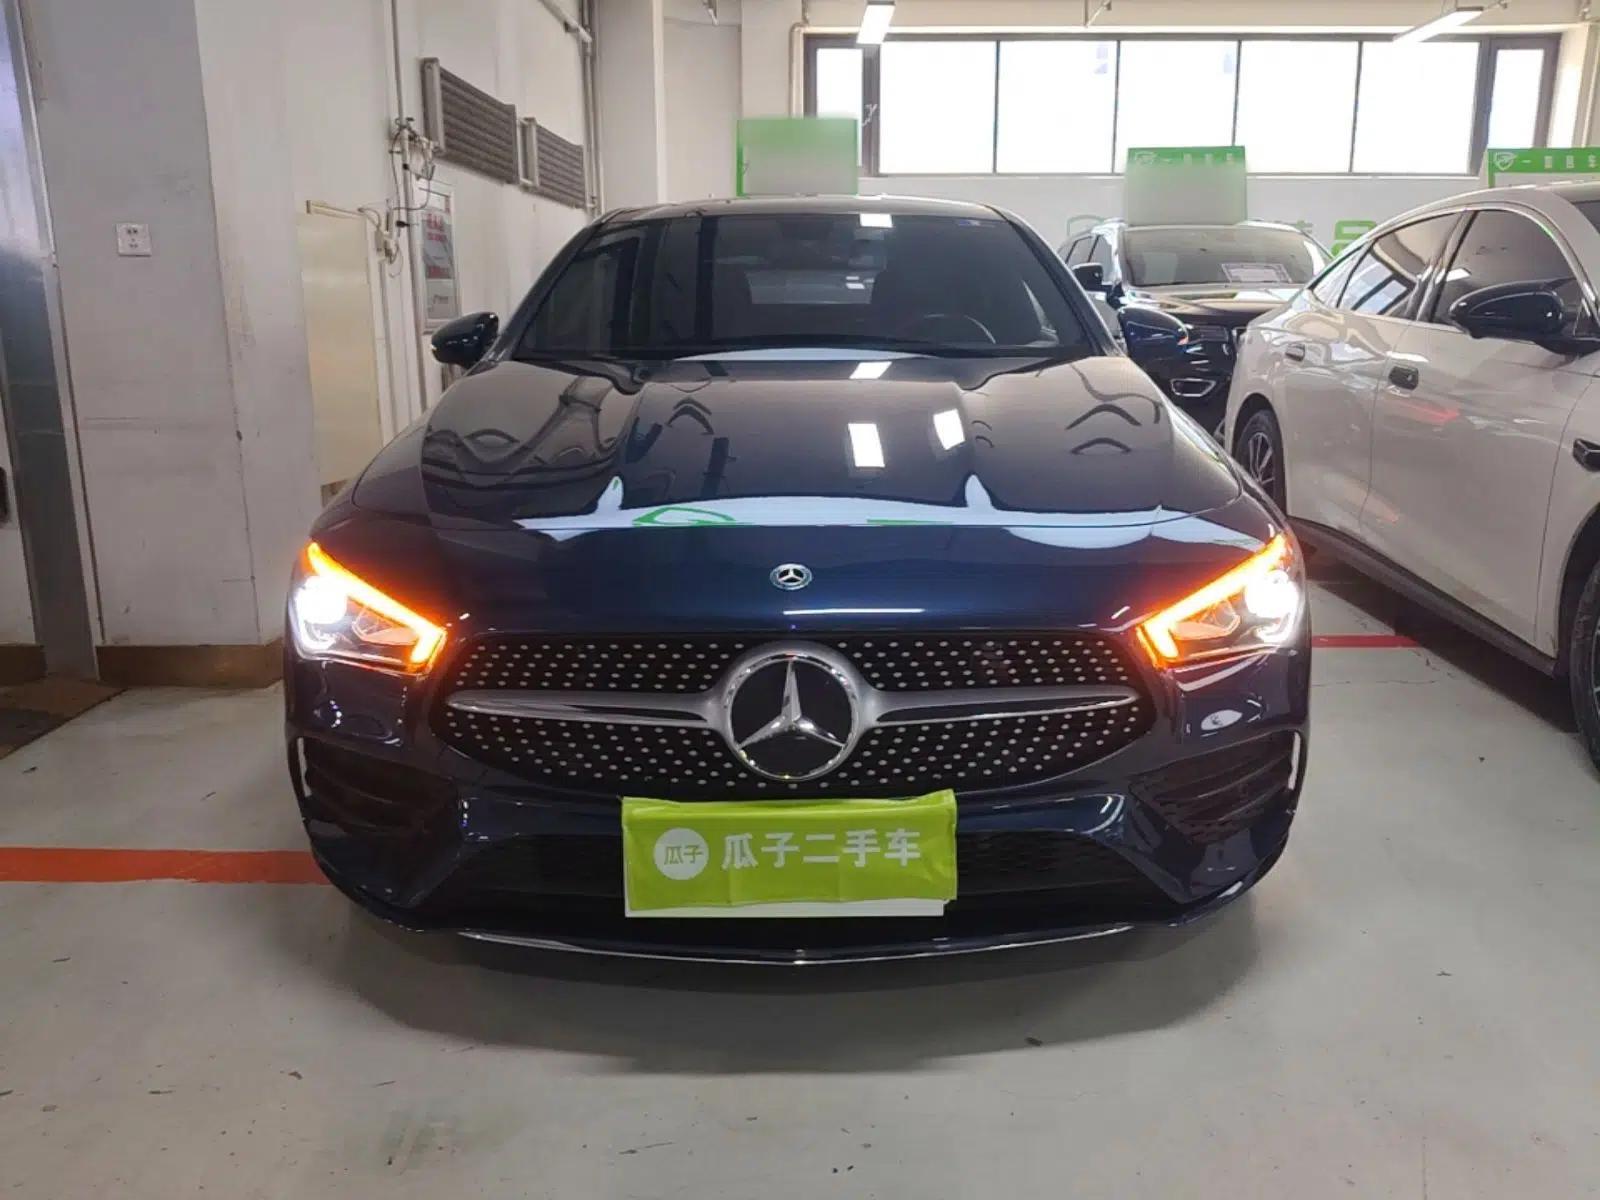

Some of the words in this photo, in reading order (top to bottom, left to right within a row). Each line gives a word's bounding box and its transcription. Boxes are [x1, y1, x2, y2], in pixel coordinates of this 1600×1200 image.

[664, 845, 704, 865] 瓜子
[722, 828, 922, 869] 瓜子二手车
